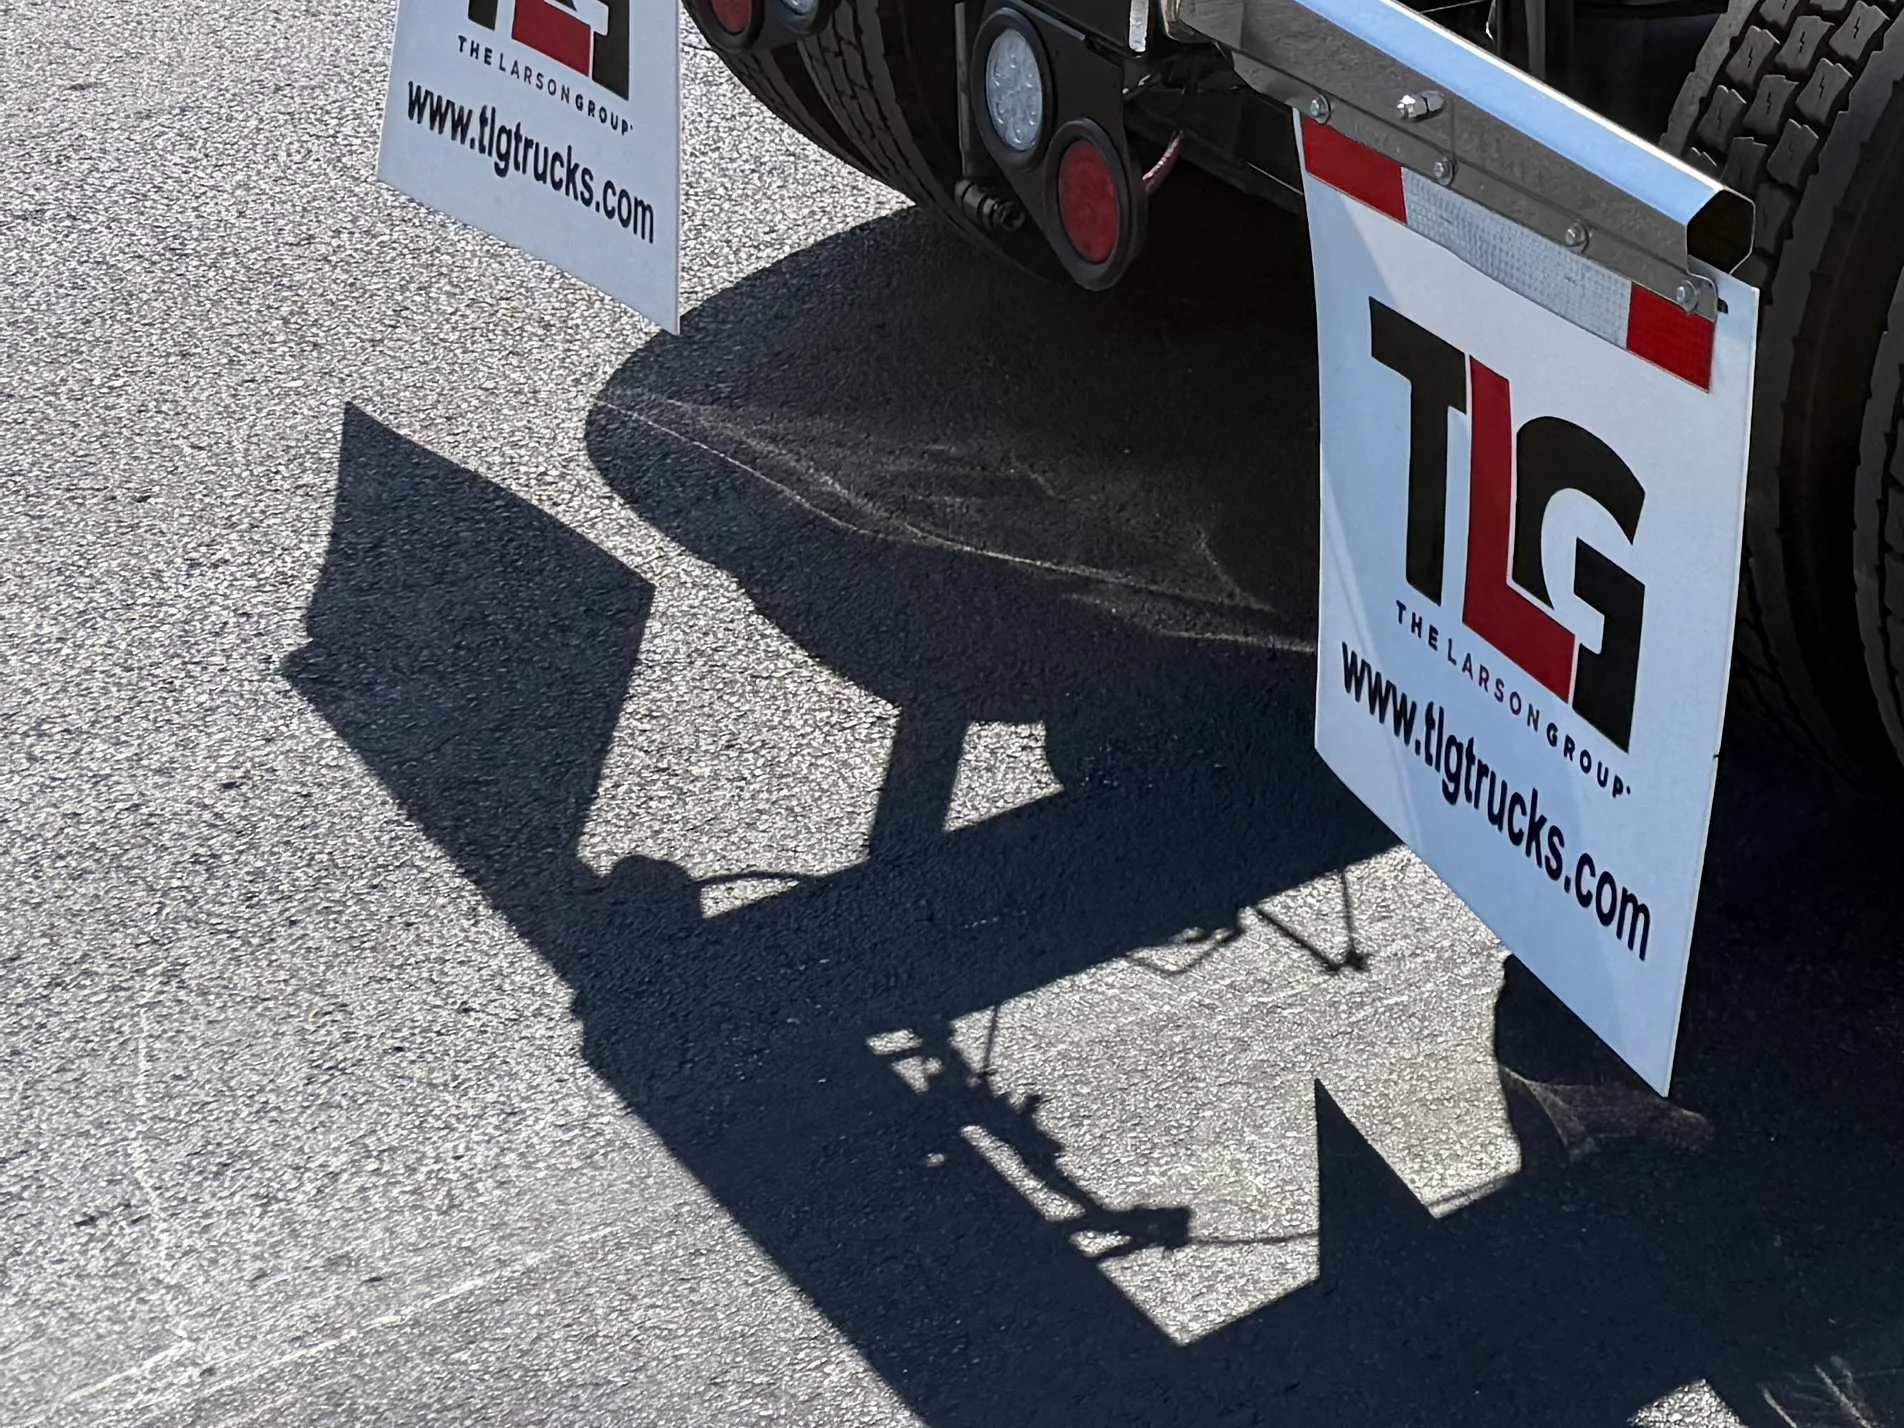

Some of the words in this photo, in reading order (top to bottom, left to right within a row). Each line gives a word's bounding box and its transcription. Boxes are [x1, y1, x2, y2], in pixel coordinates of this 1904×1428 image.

[407, 79, 655, 244] www.tlgtrucks.com
[458, 35, 493, 66] THE
[499, 52, 571, 103] LARSON
[575, 92, 630, 136] GROUP
[1368, 295, 1646, 754] TLG
[1395, 599, 1439, 651] THE
[1447, 637, 1540, 733] LARSON
[1546, 721, 1624, 799] GROUP
[1342, 640, 1651, 962] www.tlgtrucks.com
